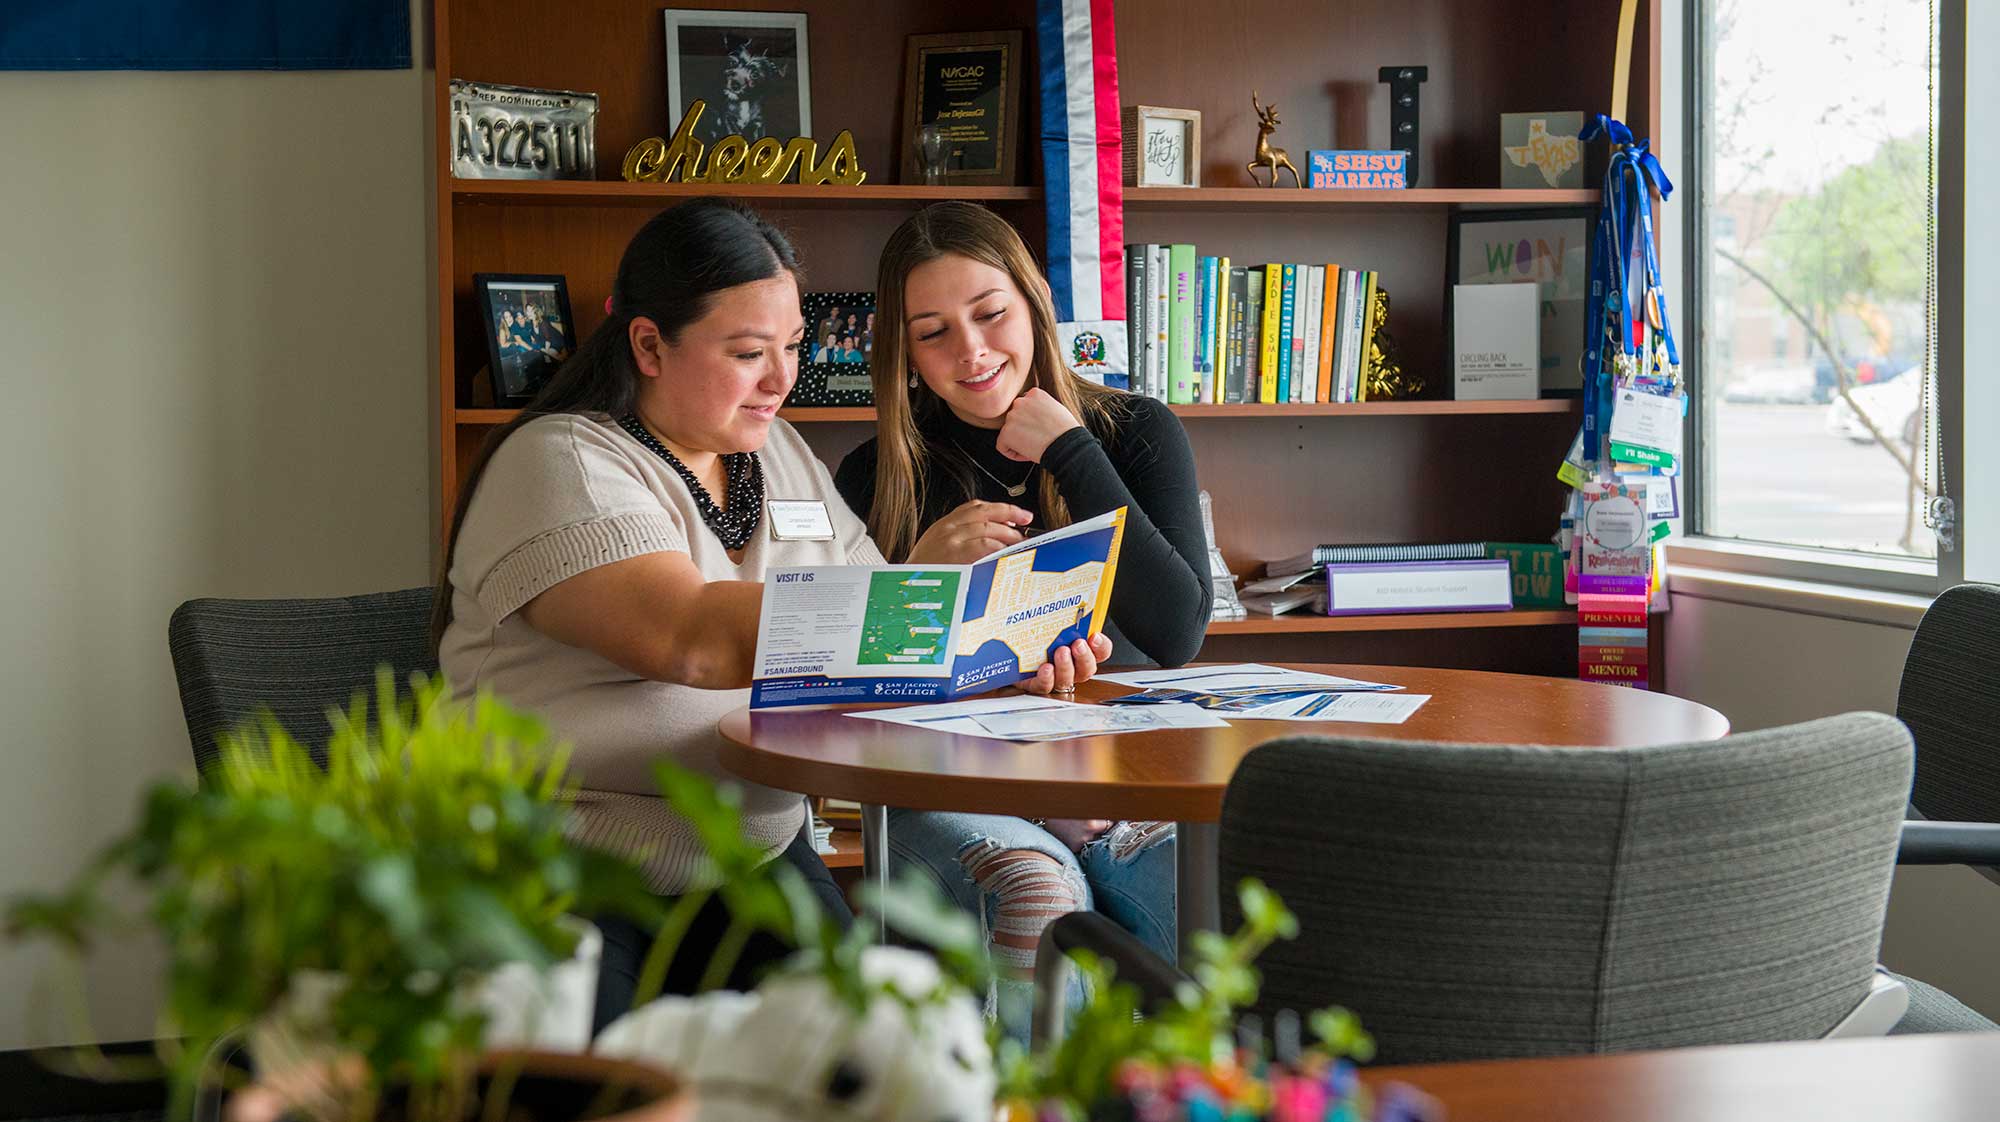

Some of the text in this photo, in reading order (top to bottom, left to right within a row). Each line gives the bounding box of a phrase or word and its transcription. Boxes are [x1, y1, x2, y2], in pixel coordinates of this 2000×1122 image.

[500, 95, 561, 108] DOMINICANA
[622, 99, 866, 185] cheers
[1334, 155, 1402, 171] SHSU
[1513, 137, 1578, 173] TEXAS
[1313, 172, 1403, 188] BEARKATS
[1177, 272, 1189, 303] WILL
[1266, 269, 1279, 385] ZADIE SMITH
[1637, 450, 1660, 461] Shake
[776, 573, 815, 583] VISIT US
[1441, 584, 1468, 594] Support
[1006, 595, 1082, 625] #SANJACBOUND
[1584, 614, 1641, 623] PRESENTER
[764, 665, 824, 676] #SANJACBOUND
[965, 665, 1011, 685] COLLEGE
[966, 660, 1012, 677] SAN JACINTO
[1588, 665, 1638, 676] MENTOR
[884, 688, 937, 696] COLLEGE
